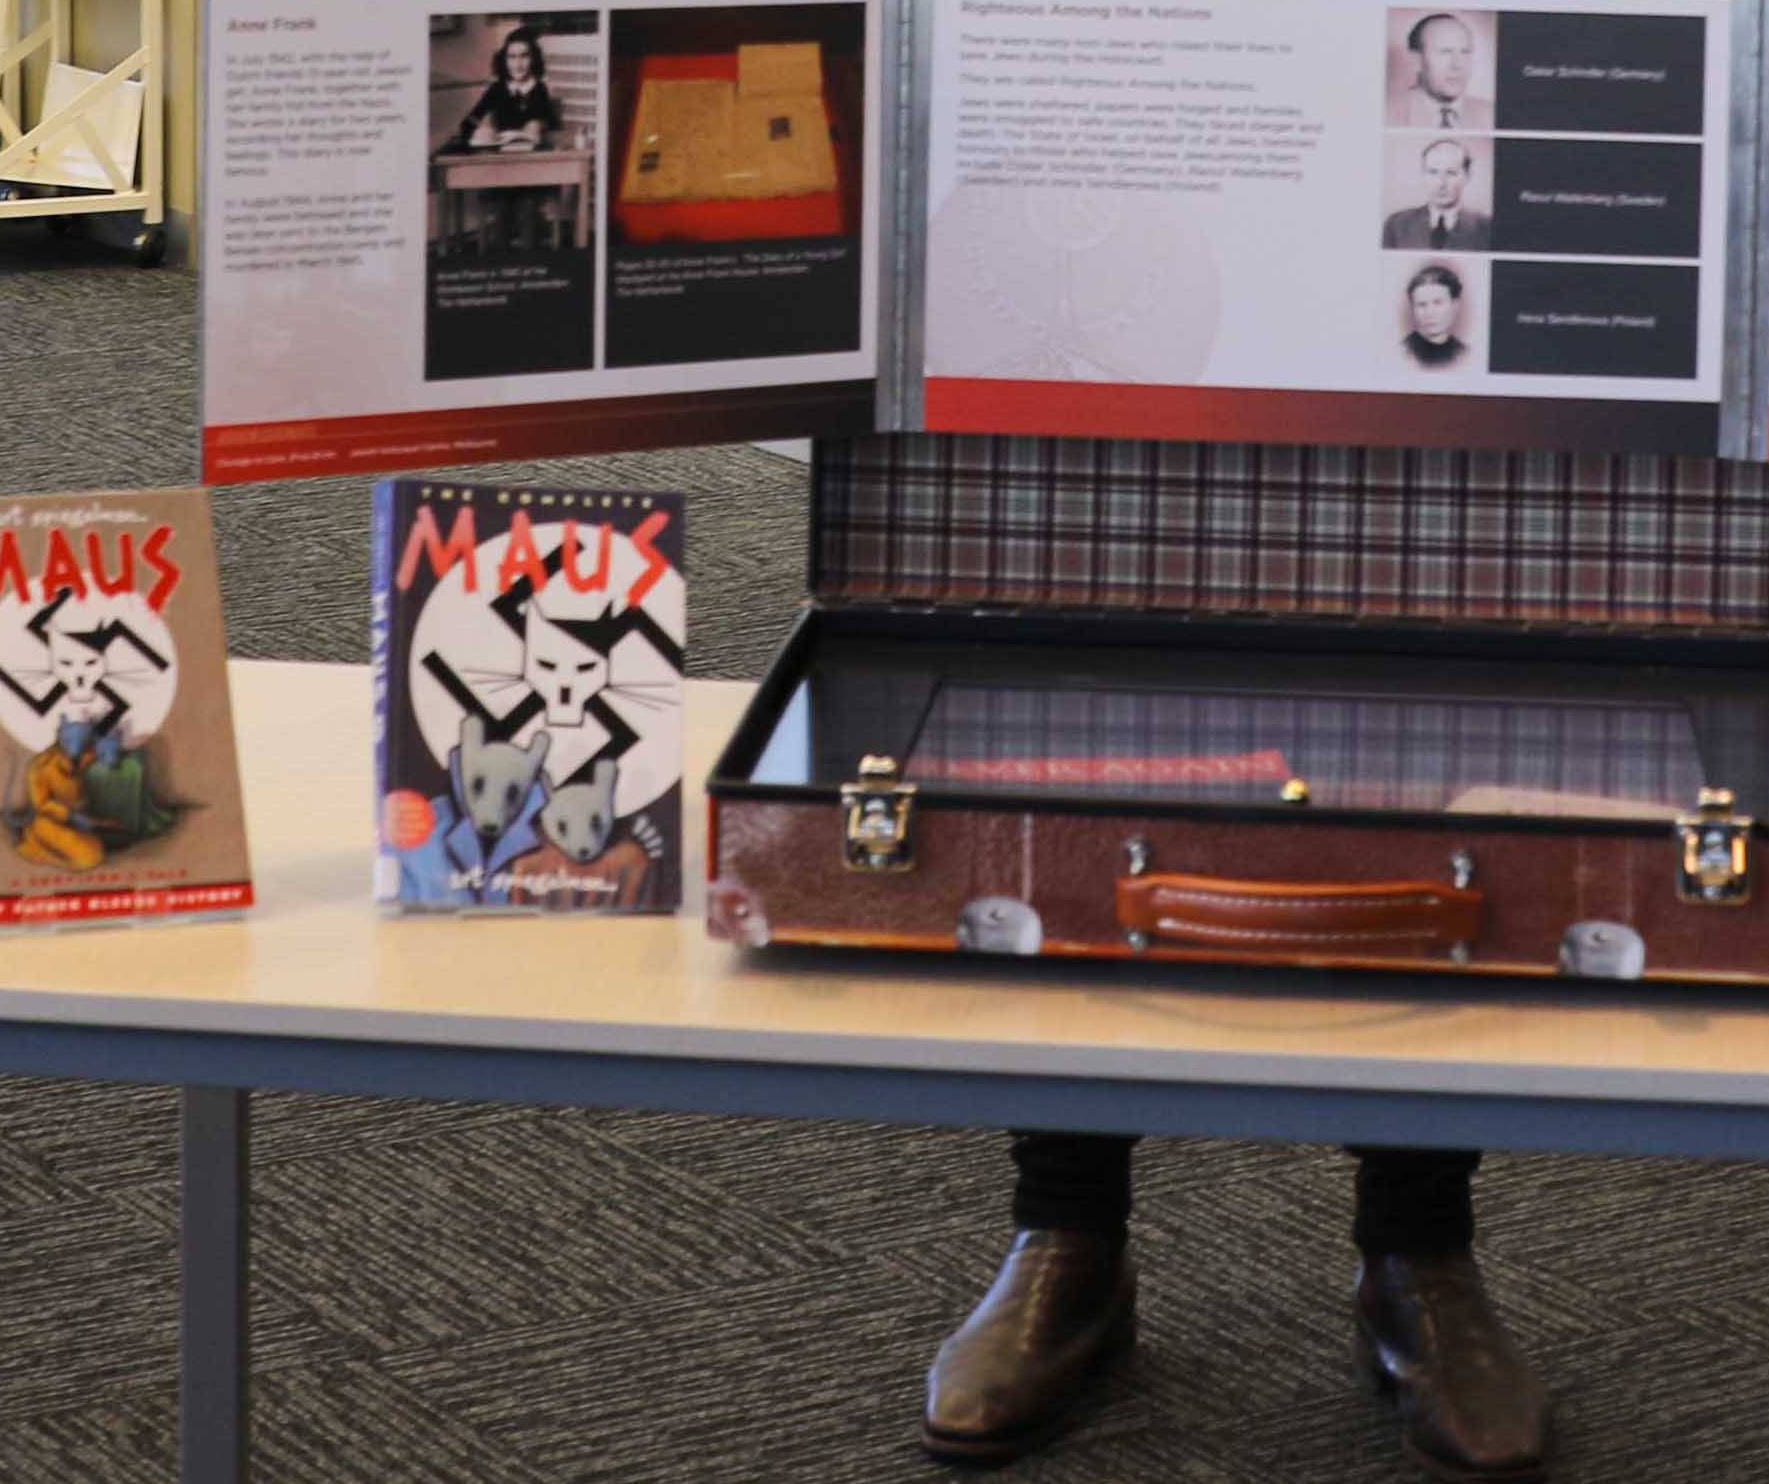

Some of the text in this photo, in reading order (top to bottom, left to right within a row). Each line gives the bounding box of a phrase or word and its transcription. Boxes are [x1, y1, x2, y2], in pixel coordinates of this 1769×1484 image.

[960, 2, 1212, 18] Righteous Among the Nations
[272, 17, 316, 31] Frank
[421, 487, 653, 509] THE COMPLETE
[395, 504, 672, 609] MAUS
[166, 888, 243, 905] HISTORY
